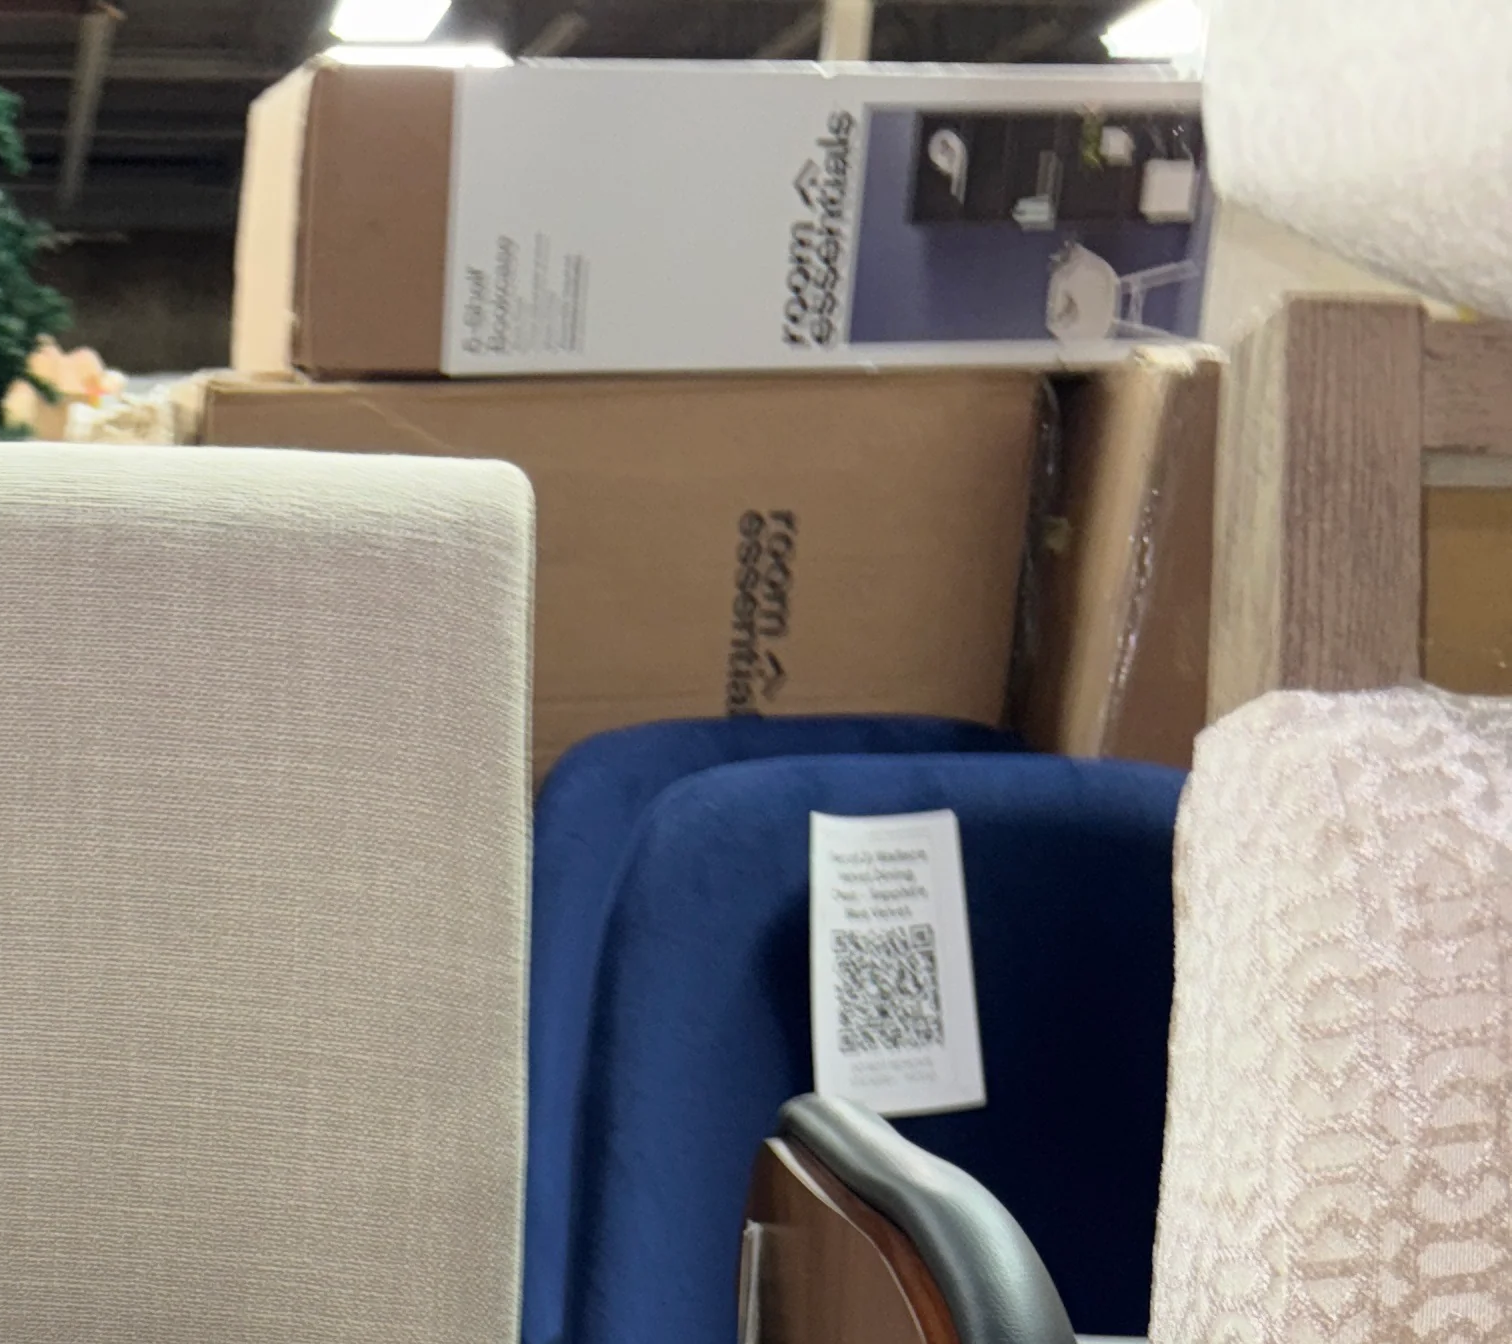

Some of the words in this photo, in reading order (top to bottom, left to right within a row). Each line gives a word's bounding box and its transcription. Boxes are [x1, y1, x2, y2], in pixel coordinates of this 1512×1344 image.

[781, 220, 815, 348] room
[809, 109, 856, 346] essentials
[756, 510, 796, 637] room
